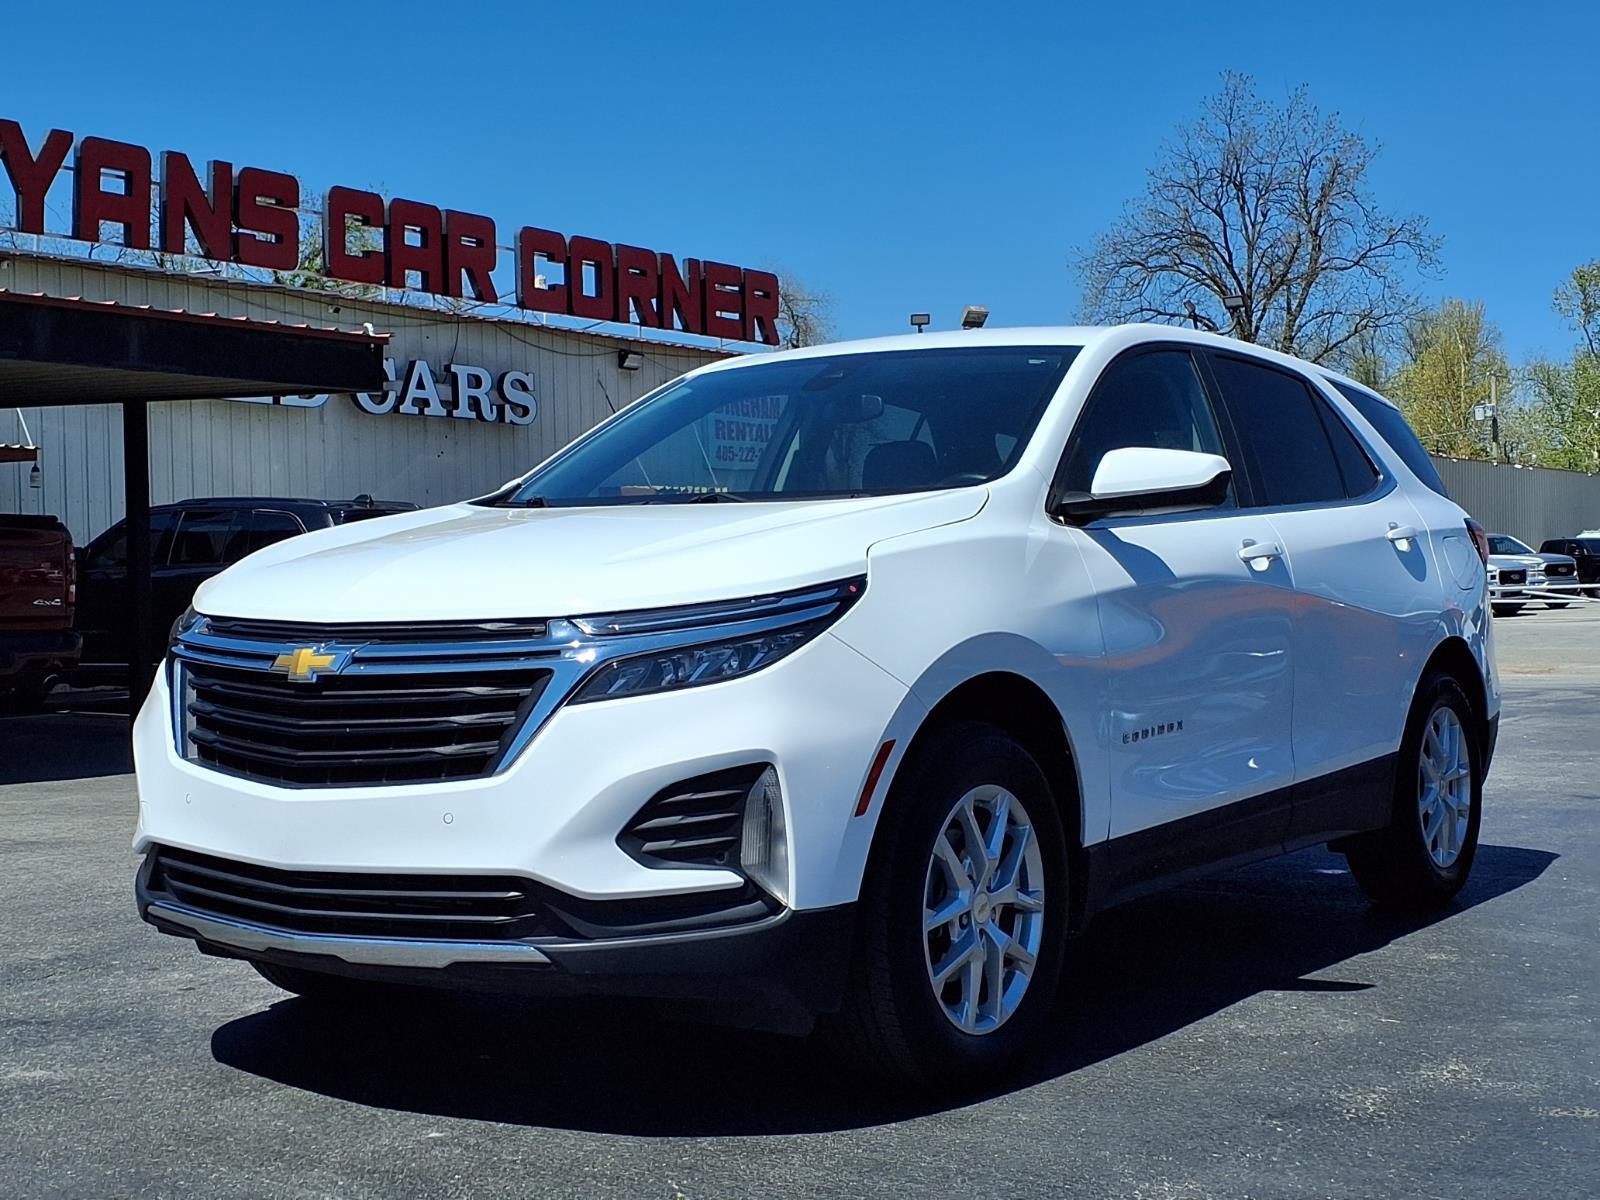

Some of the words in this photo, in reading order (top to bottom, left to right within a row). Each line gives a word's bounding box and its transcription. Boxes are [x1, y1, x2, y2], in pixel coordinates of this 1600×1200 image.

[0, 118, 299, 271] YANS
[323, 185, 498, 303] CAR
[514, 226, 780, 345] CORNER
[714, 397, 780, 419] INGHAM
[1122, 720, 1183, 744] EQUINOX
